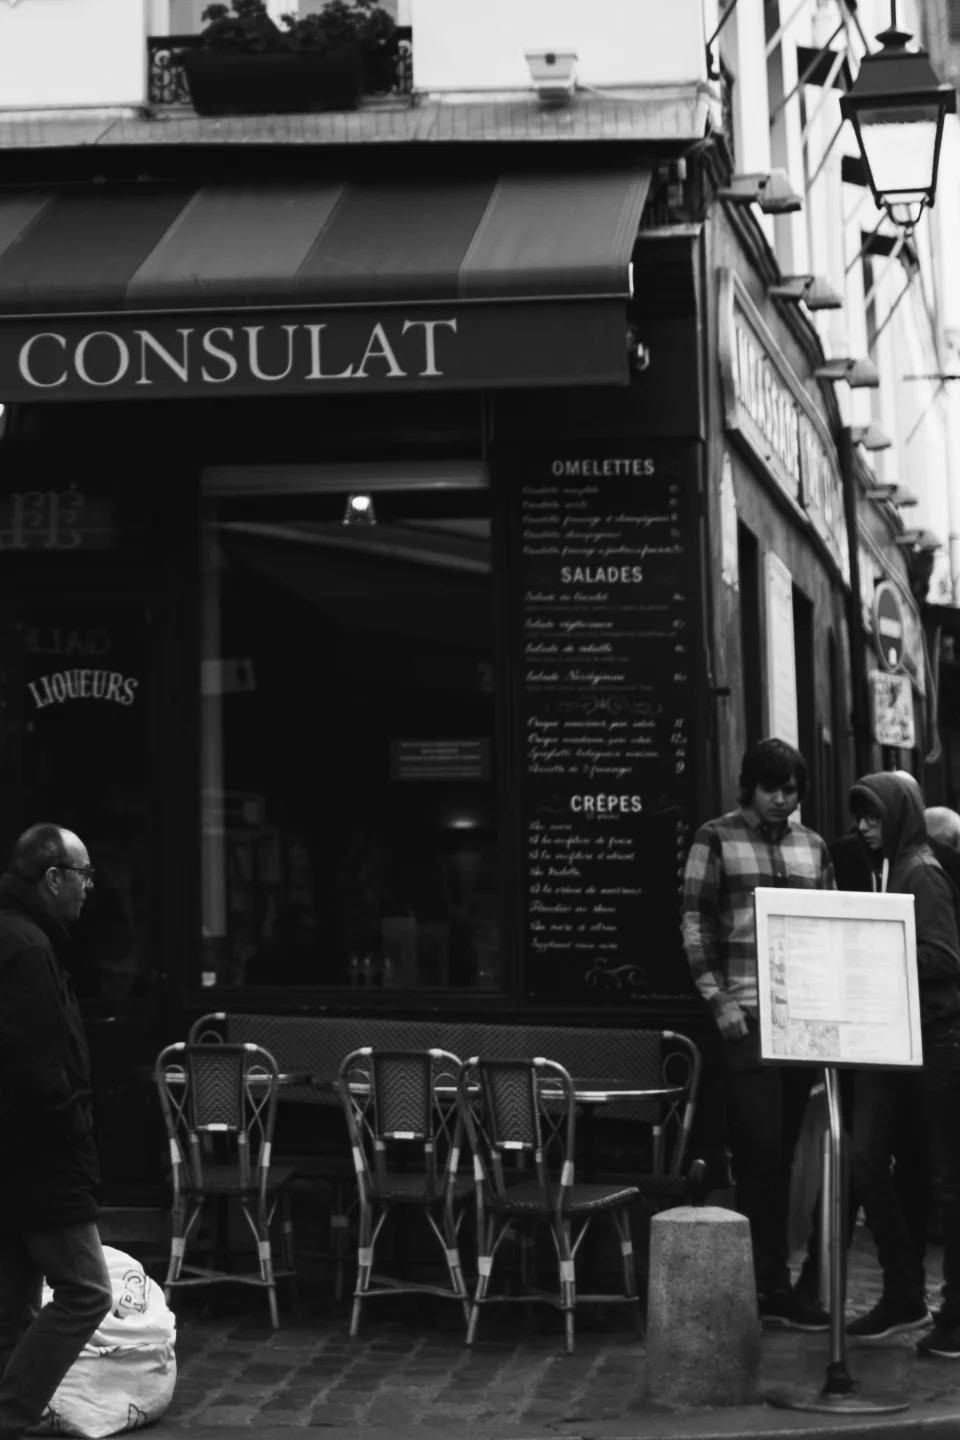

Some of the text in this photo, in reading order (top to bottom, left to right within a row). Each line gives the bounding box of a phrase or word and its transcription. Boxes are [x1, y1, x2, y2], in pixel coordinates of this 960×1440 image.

[17, 318, 457, 387] CONSULAT
[552, 459, 655, 476] OMELETTES
[561, 566, 643, 583] SALADES
[27, 668, 140, 709] LIQUEURS
[570, 792, 642, 813] CRÊPES
